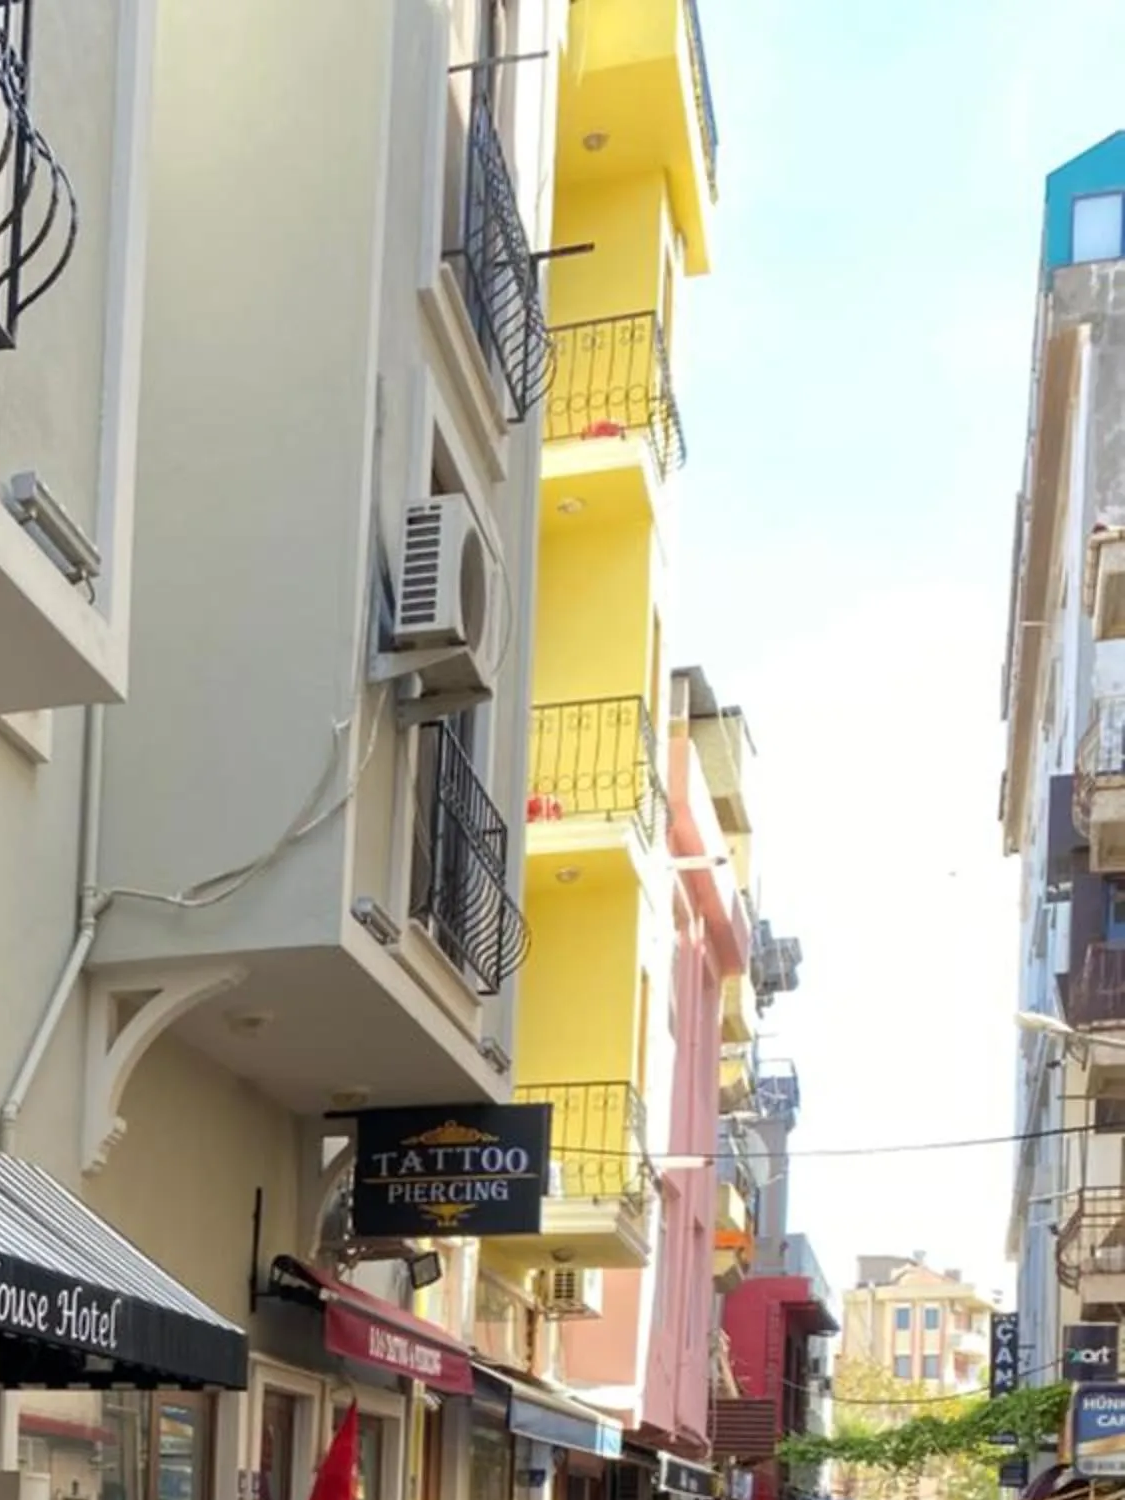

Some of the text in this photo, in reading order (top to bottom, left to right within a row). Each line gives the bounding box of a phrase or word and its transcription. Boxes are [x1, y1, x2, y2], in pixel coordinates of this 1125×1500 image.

[372, 1146, 529, 1177] TATTOO
[388, 1180, 509, 1204] PIERCING
[55, 1286, 122, 1349] Hotel
